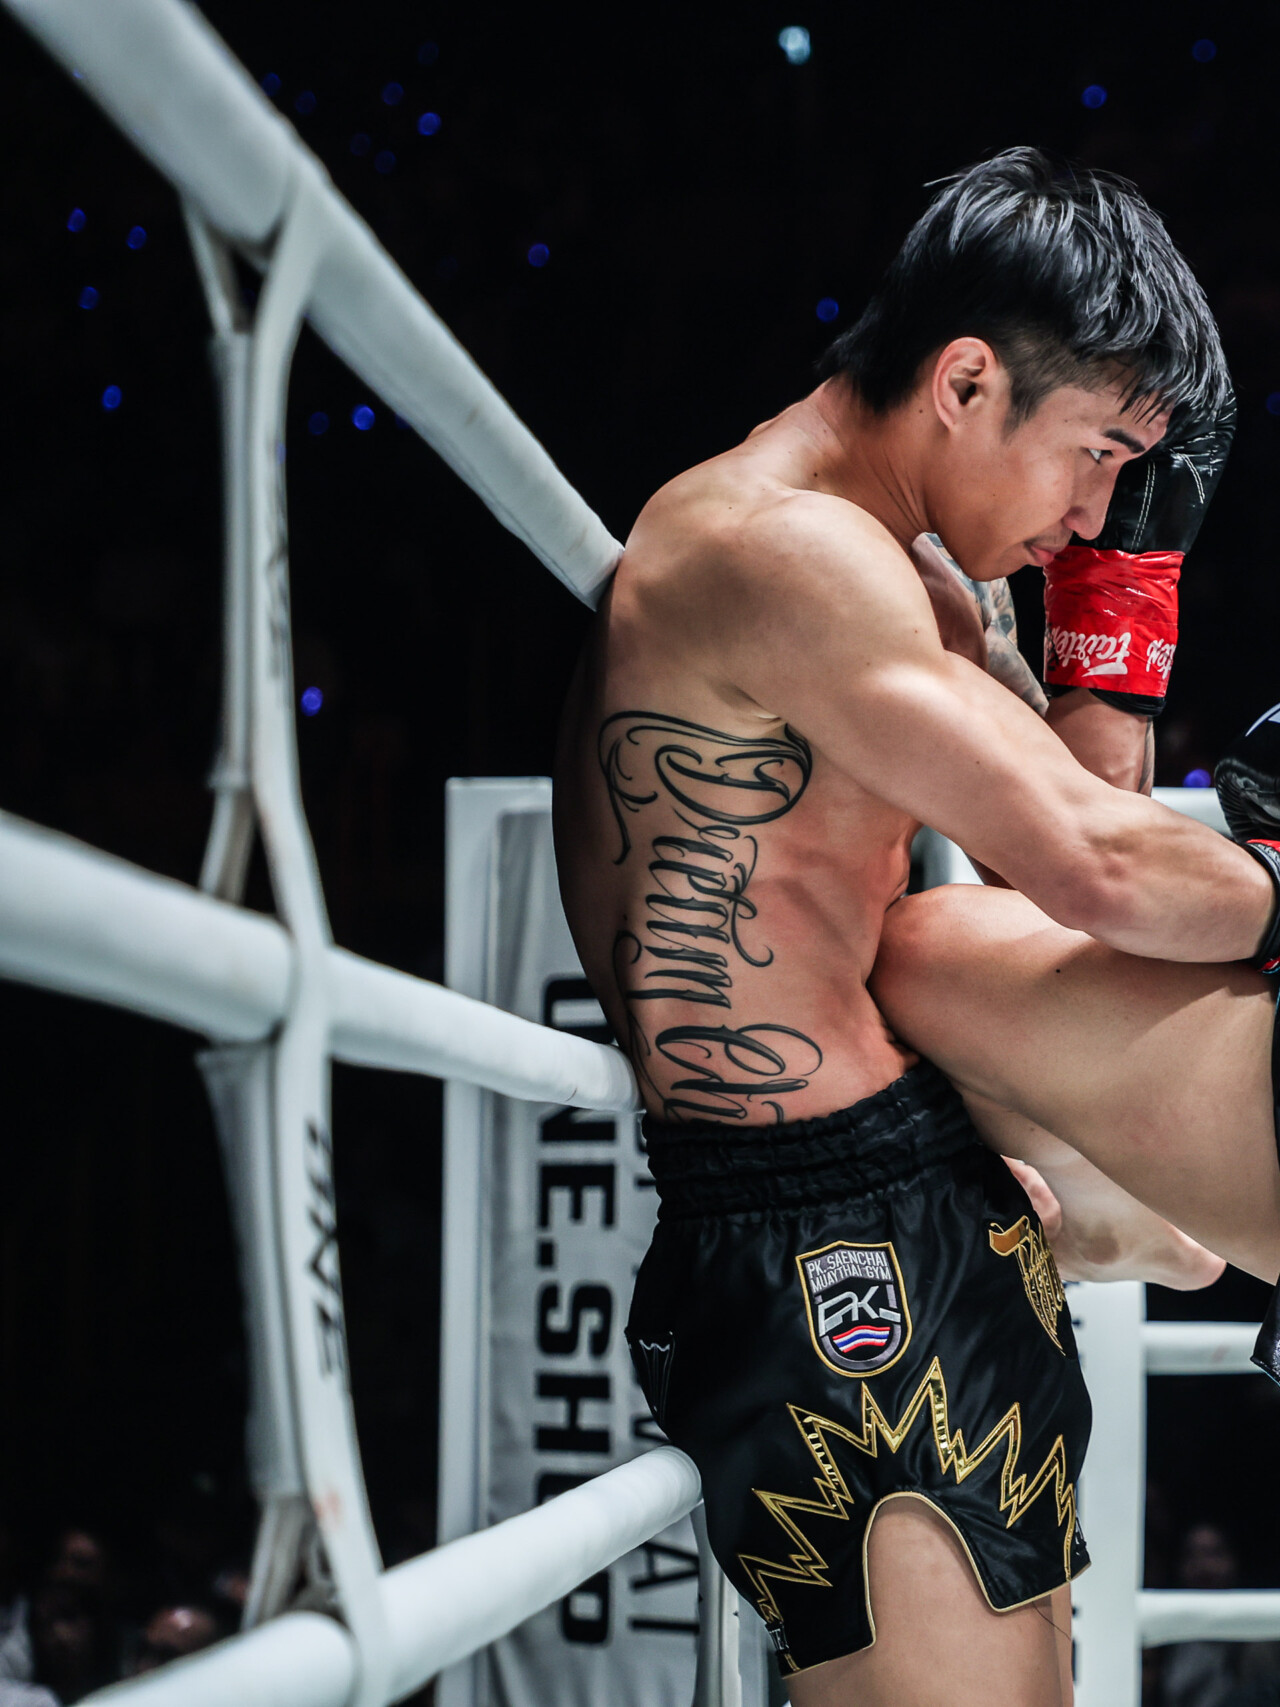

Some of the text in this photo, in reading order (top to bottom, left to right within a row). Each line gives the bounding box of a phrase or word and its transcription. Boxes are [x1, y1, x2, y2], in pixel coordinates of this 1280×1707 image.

[600, 711, 823, 1126] Dream Ch
[826, 1251, 888, 1270] SAENCHAI
[865, 1265, 892, 1280] GYM
